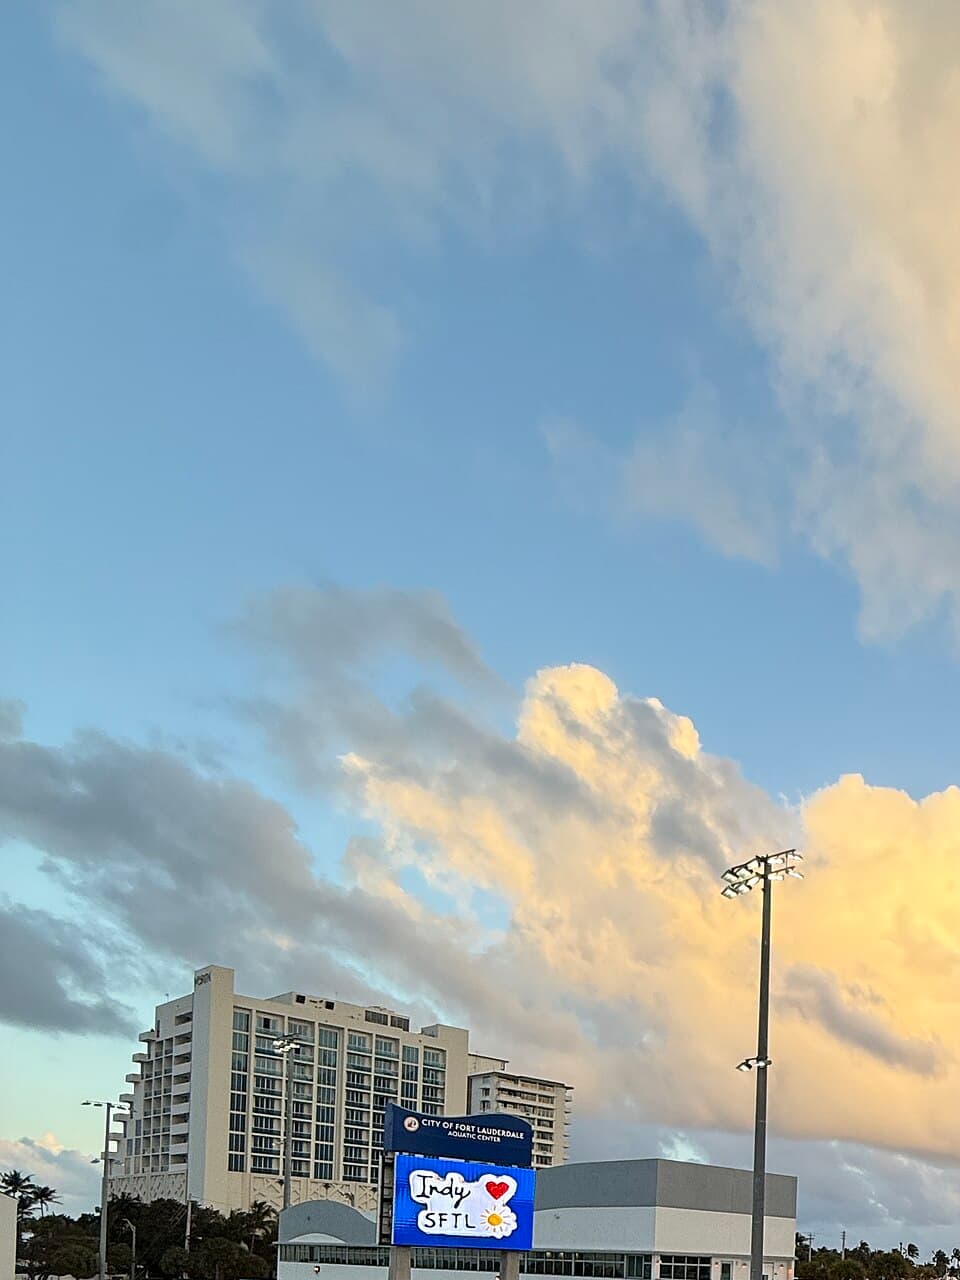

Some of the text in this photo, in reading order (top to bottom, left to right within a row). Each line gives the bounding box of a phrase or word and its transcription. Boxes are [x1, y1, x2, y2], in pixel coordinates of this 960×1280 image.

[421, 1118, 525, 1140] CITY OF FORT LAUDERDALE
[447, 1130, 501, 1143] AQUATIC CENTER
[415, 1174, 471, 1209] Indy
[424, 1212, 476, 1229] SFTL
